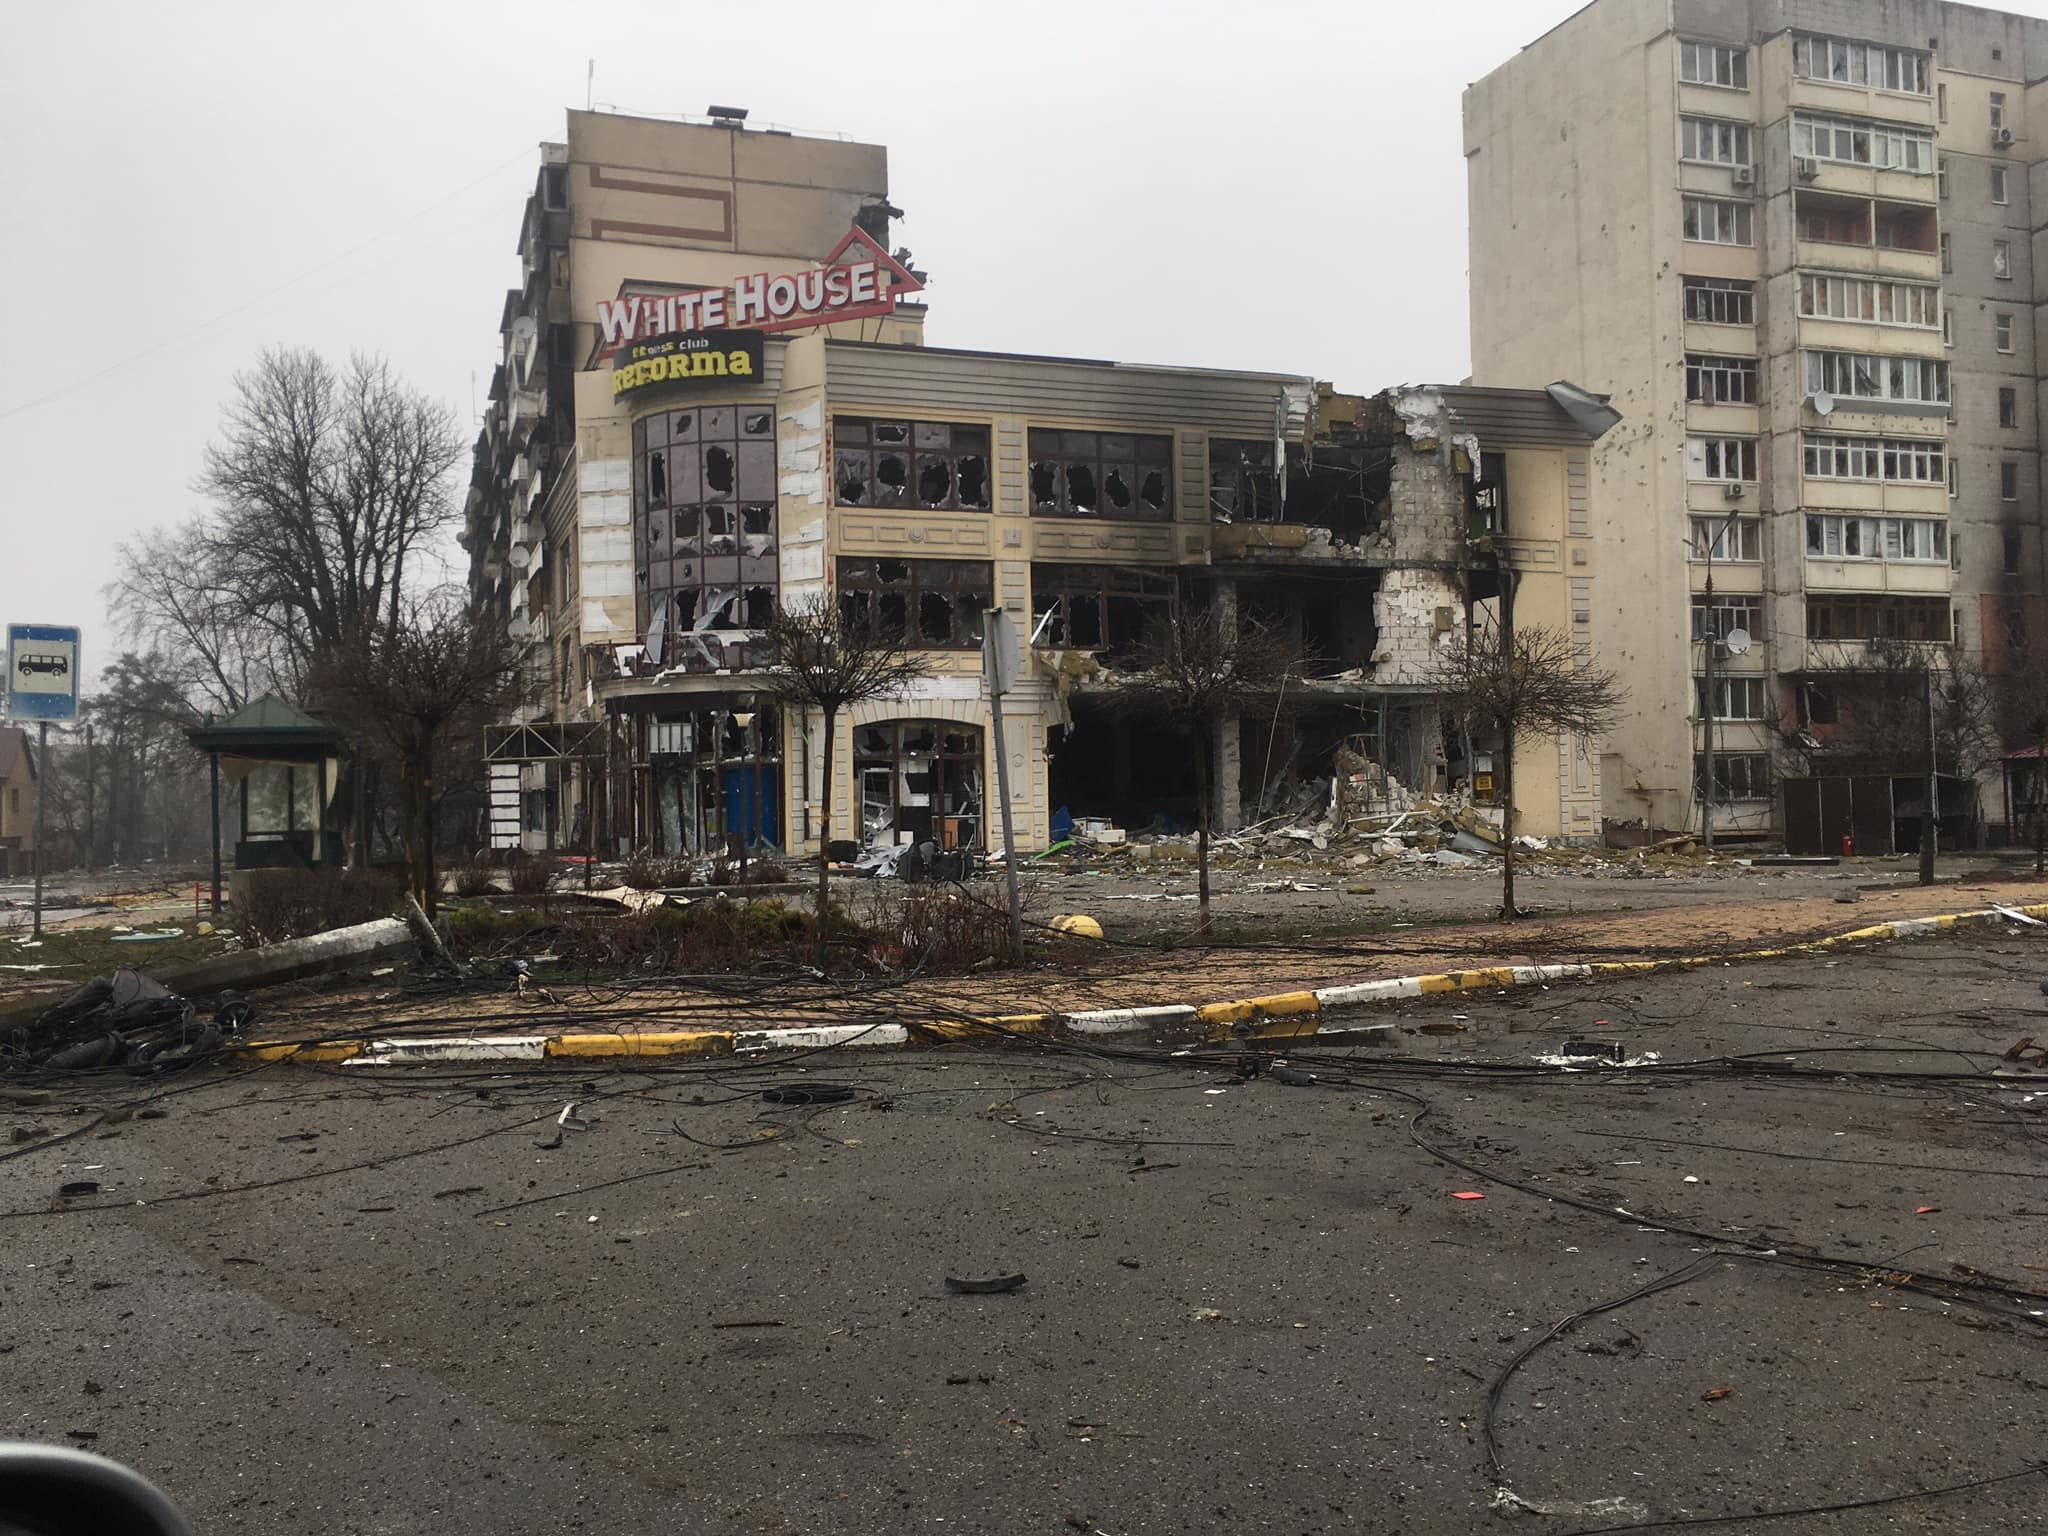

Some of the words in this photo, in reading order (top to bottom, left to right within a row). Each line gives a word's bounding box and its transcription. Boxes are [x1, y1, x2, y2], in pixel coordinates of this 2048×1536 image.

[597, 288, 725, 342] WHITE
[735, 262, 875, 321] HOUSE
[679, 338, 709, 350] club
